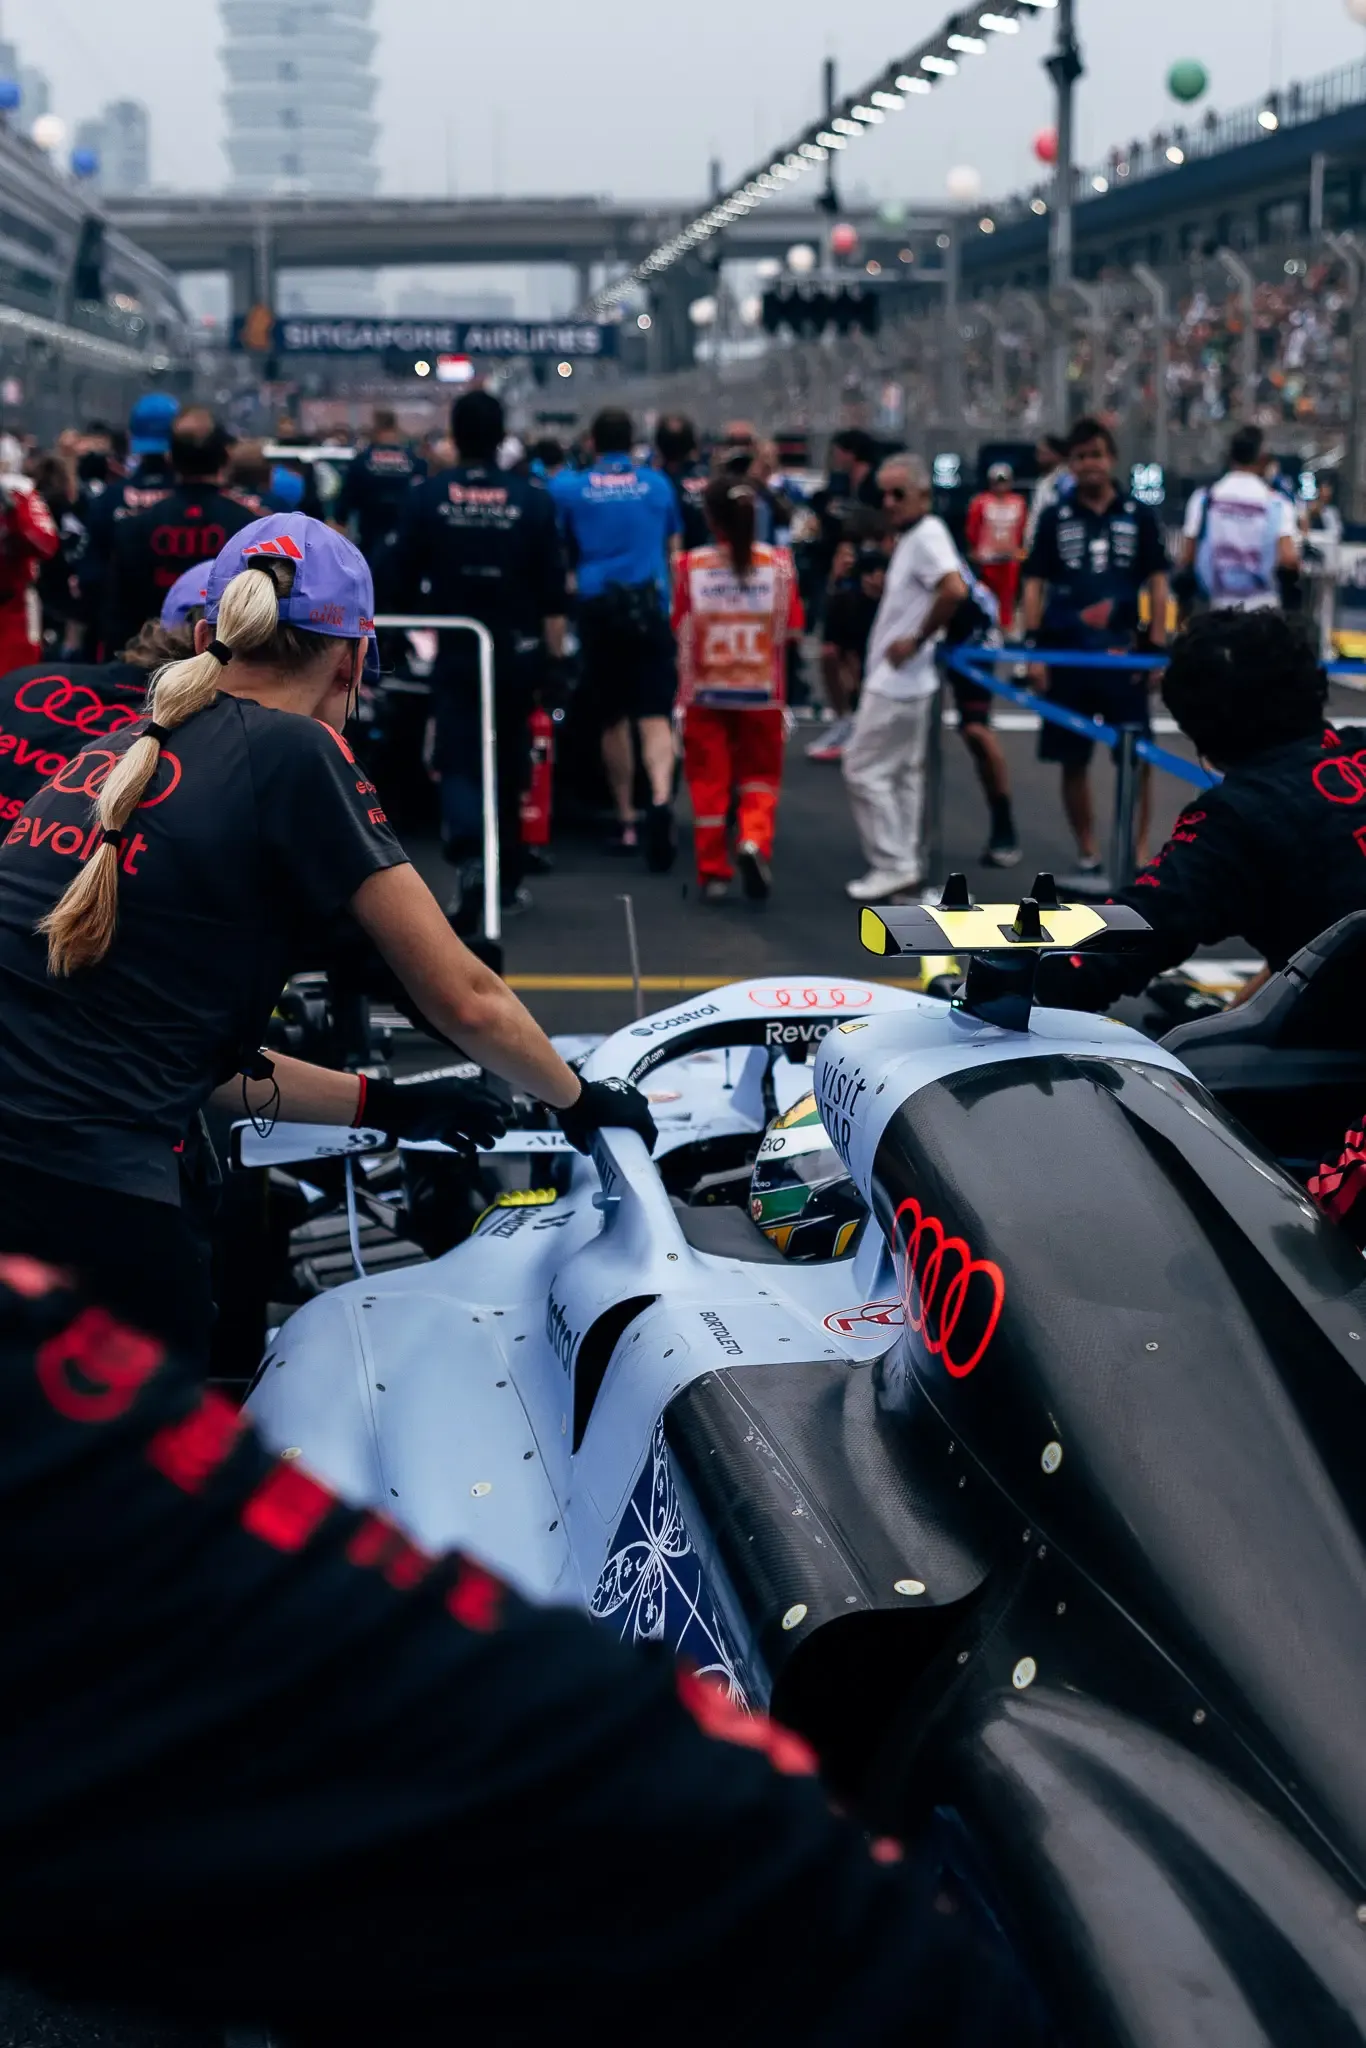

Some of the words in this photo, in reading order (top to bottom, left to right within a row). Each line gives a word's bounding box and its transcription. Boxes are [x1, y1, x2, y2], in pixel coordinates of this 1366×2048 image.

[283, 324, 455, 350] SINGAPORE
[465, 325, 601, 352] AIRLINES
[650, 1004, 721, 1031] Castrol
[822, 1057, 867, 1117] visit
[699, 1311, 744, 1355] BORTOLETO
